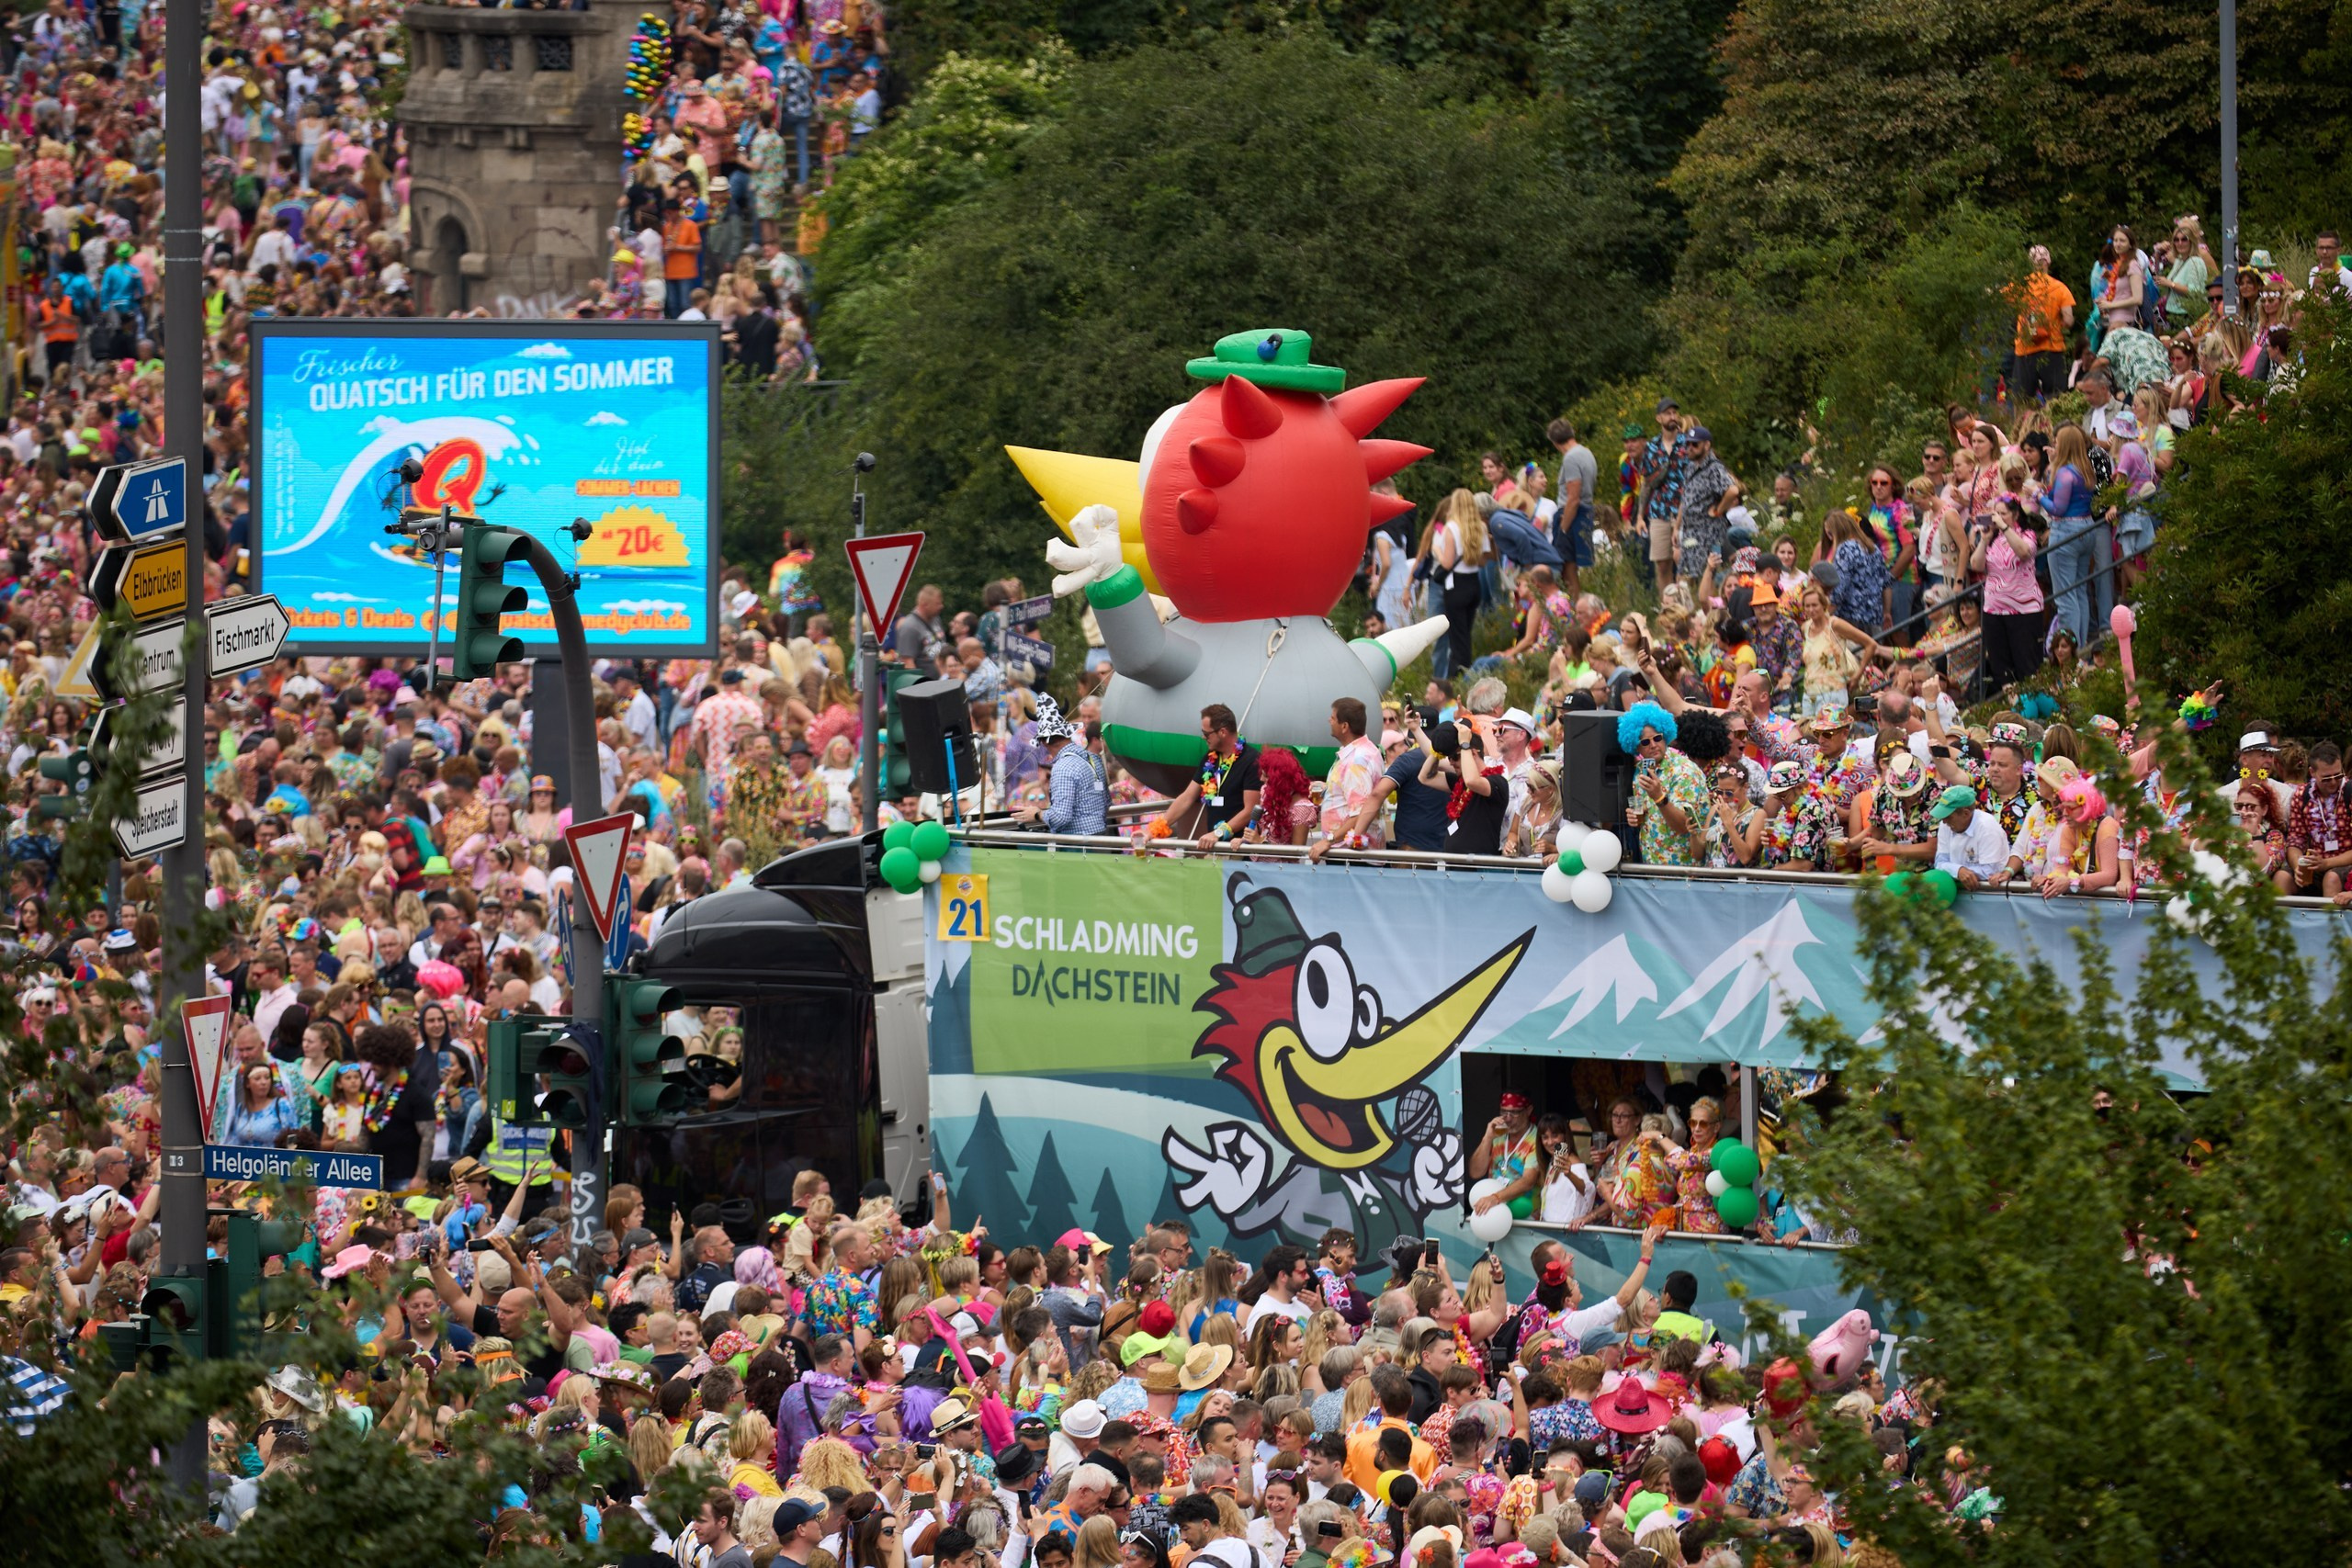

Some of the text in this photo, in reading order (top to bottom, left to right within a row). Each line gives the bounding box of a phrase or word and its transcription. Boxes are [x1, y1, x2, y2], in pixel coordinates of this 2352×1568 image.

[293, 346, 404, 383] Frischer
[310, 356, 673, 412] QUATSCH FÜR DEN SOMMER
[616, 525, 665, 557] 20€
[133, 566, 182, 601] Elbbrücken
[216, 617, 275, 657] Fischmarkt
[131, 798, 178, 844] Speicherstadt
[948, 897, 983, 937] 21
[994, 914, 1199, 960] SCHLADMING
[1012, 959, 1182, 1007] DACHSTEIN
[212, 1150, 372, 1182] Helgoländer Allee
